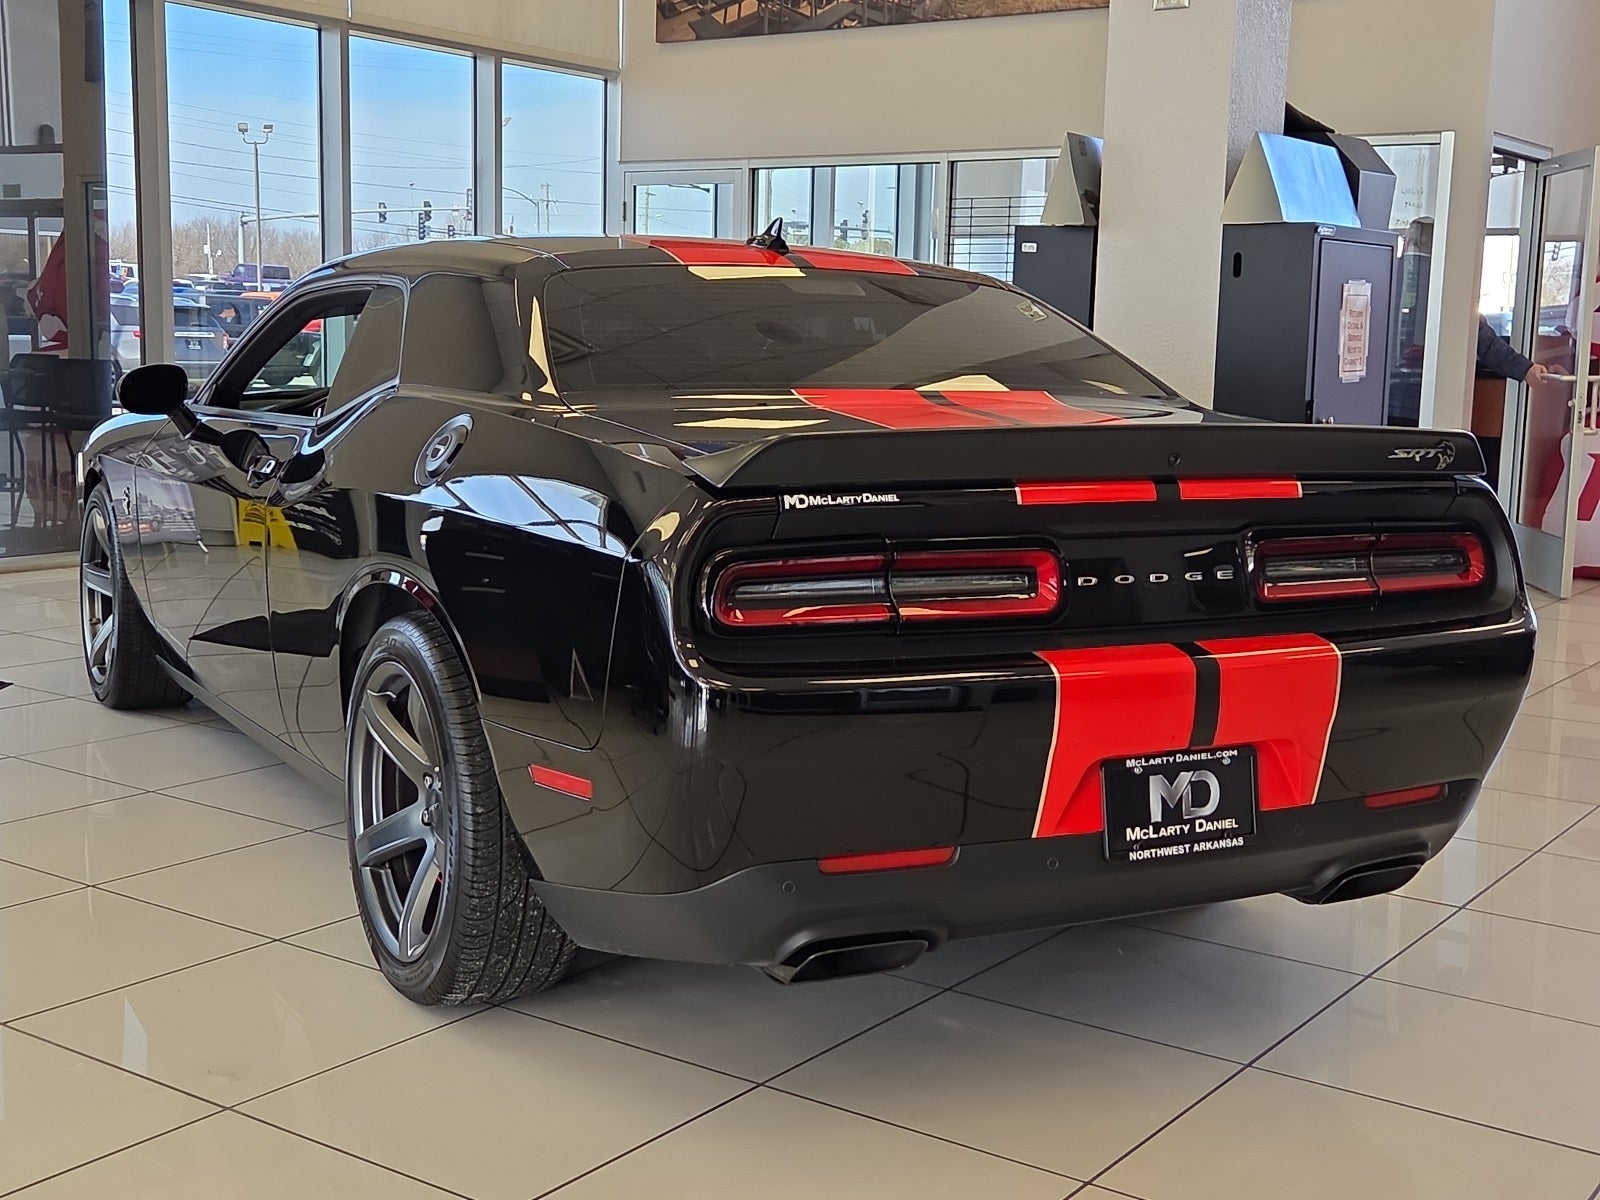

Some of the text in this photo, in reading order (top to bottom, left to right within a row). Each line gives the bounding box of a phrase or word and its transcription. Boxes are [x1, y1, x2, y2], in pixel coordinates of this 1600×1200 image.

[1387, 448, 1444, 462] SRT
[1077, 569, 1235, 587] DODGE
[1149, 769, 1221, 824] MD
[1129, 837, 1244, 861] NORTHWEST ARKANSAS
